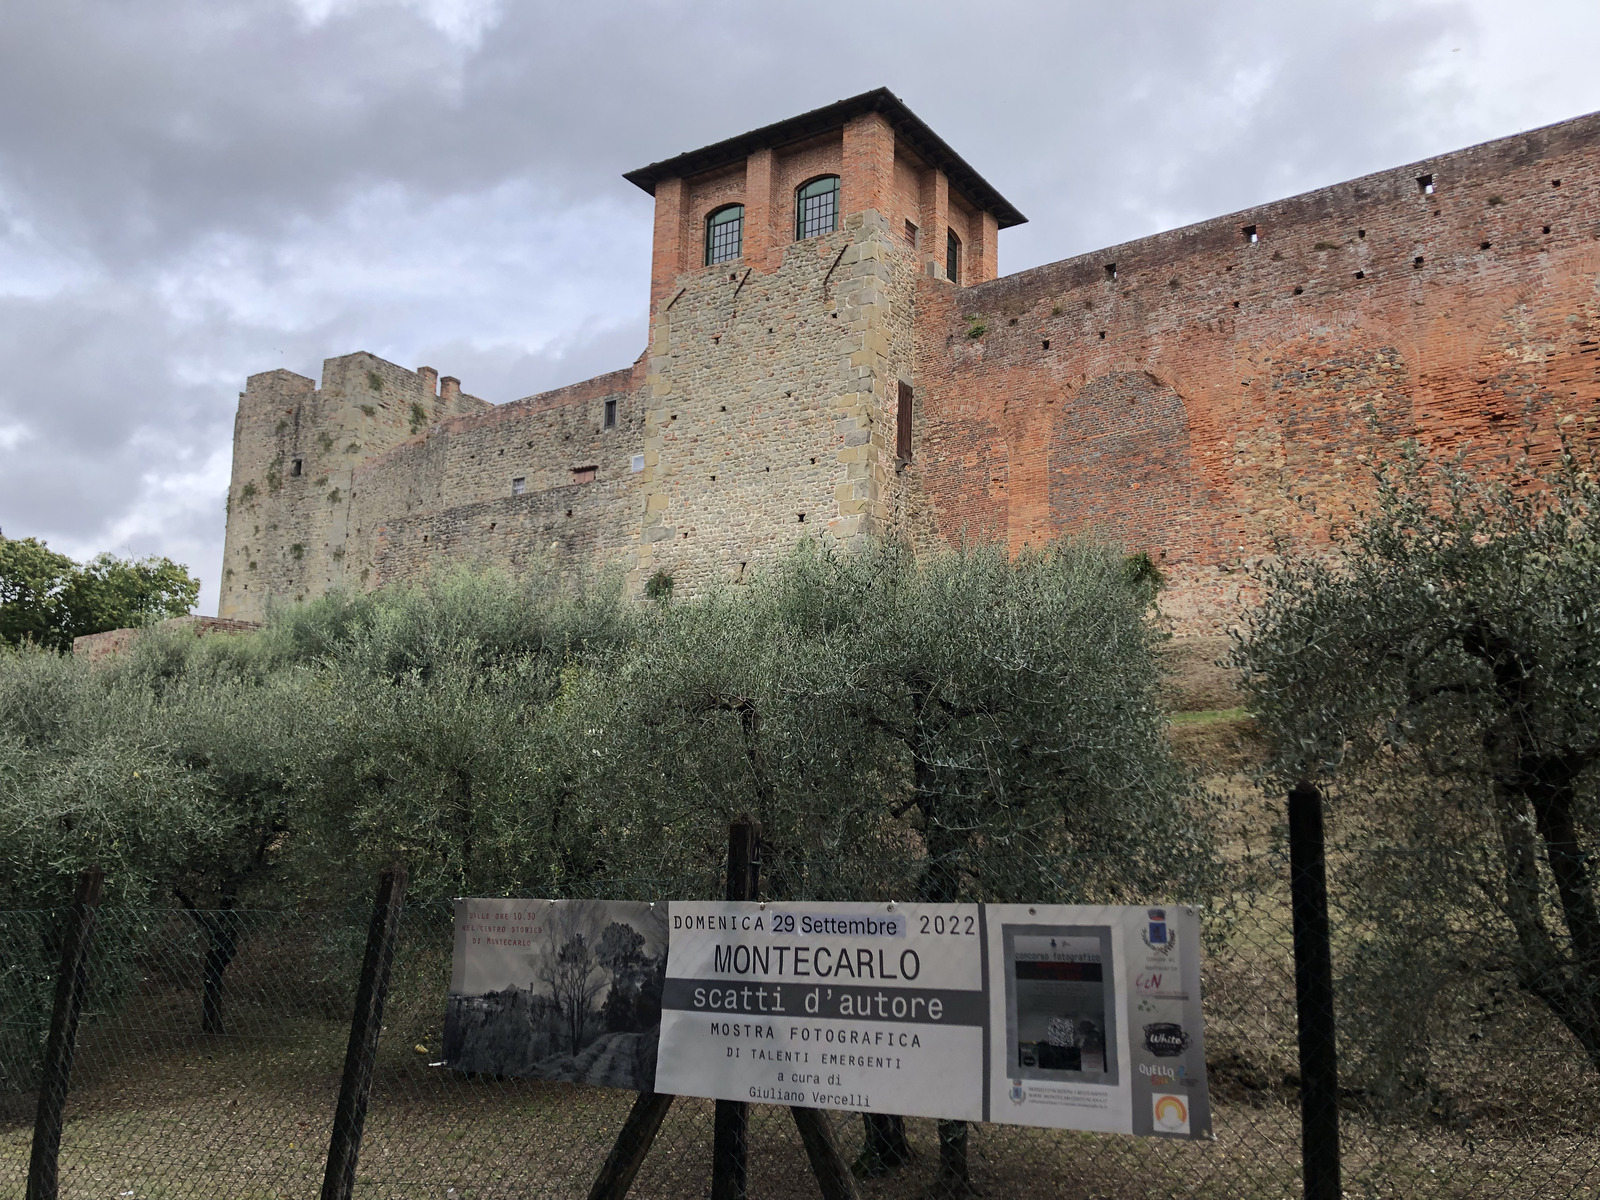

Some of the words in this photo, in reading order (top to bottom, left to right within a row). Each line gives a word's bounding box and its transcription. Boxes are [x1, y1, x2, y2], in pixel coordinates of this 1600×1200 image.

[495, 912, 509, 920] ORE
[673, 915, 764, 931] DOMENICA
[772, 915, 795, 932] 29
[801, 916, 897, 935] Settembre
[919, 915, 976, 936] 2022
[462, 924, 475, 932] NEL
[479, 925, 506, 933] CENTRO
[511, 926, 543, 934] STORICO
[714, 944, 920, 981] MONTECARLO
[693, 986, 786, 1012] scatti
[804, 988, 943, 1020] d'autore
[711, 1022, 774, 1040] MOSTRA
[790, 1027, 921, 1048] FOTOGRAFICA
[1150, 1033, 1182, 1045] White
[726, 1047, 740, 1058] DI
[751, 1049, 809, 1063] TALENTI
[821, 1054, 901, 1069] EMERGENTI
[777, 1072, 784, 1082] a
[791, 1073, 820, 1085] cura
[827, 1073, 842, 1086] di
[1138, 1063, 1175, 1079] QUELLO
[749, 1086, 805, 1103] Giuliano
[812, 1091, 871, 1108] Vercelli
